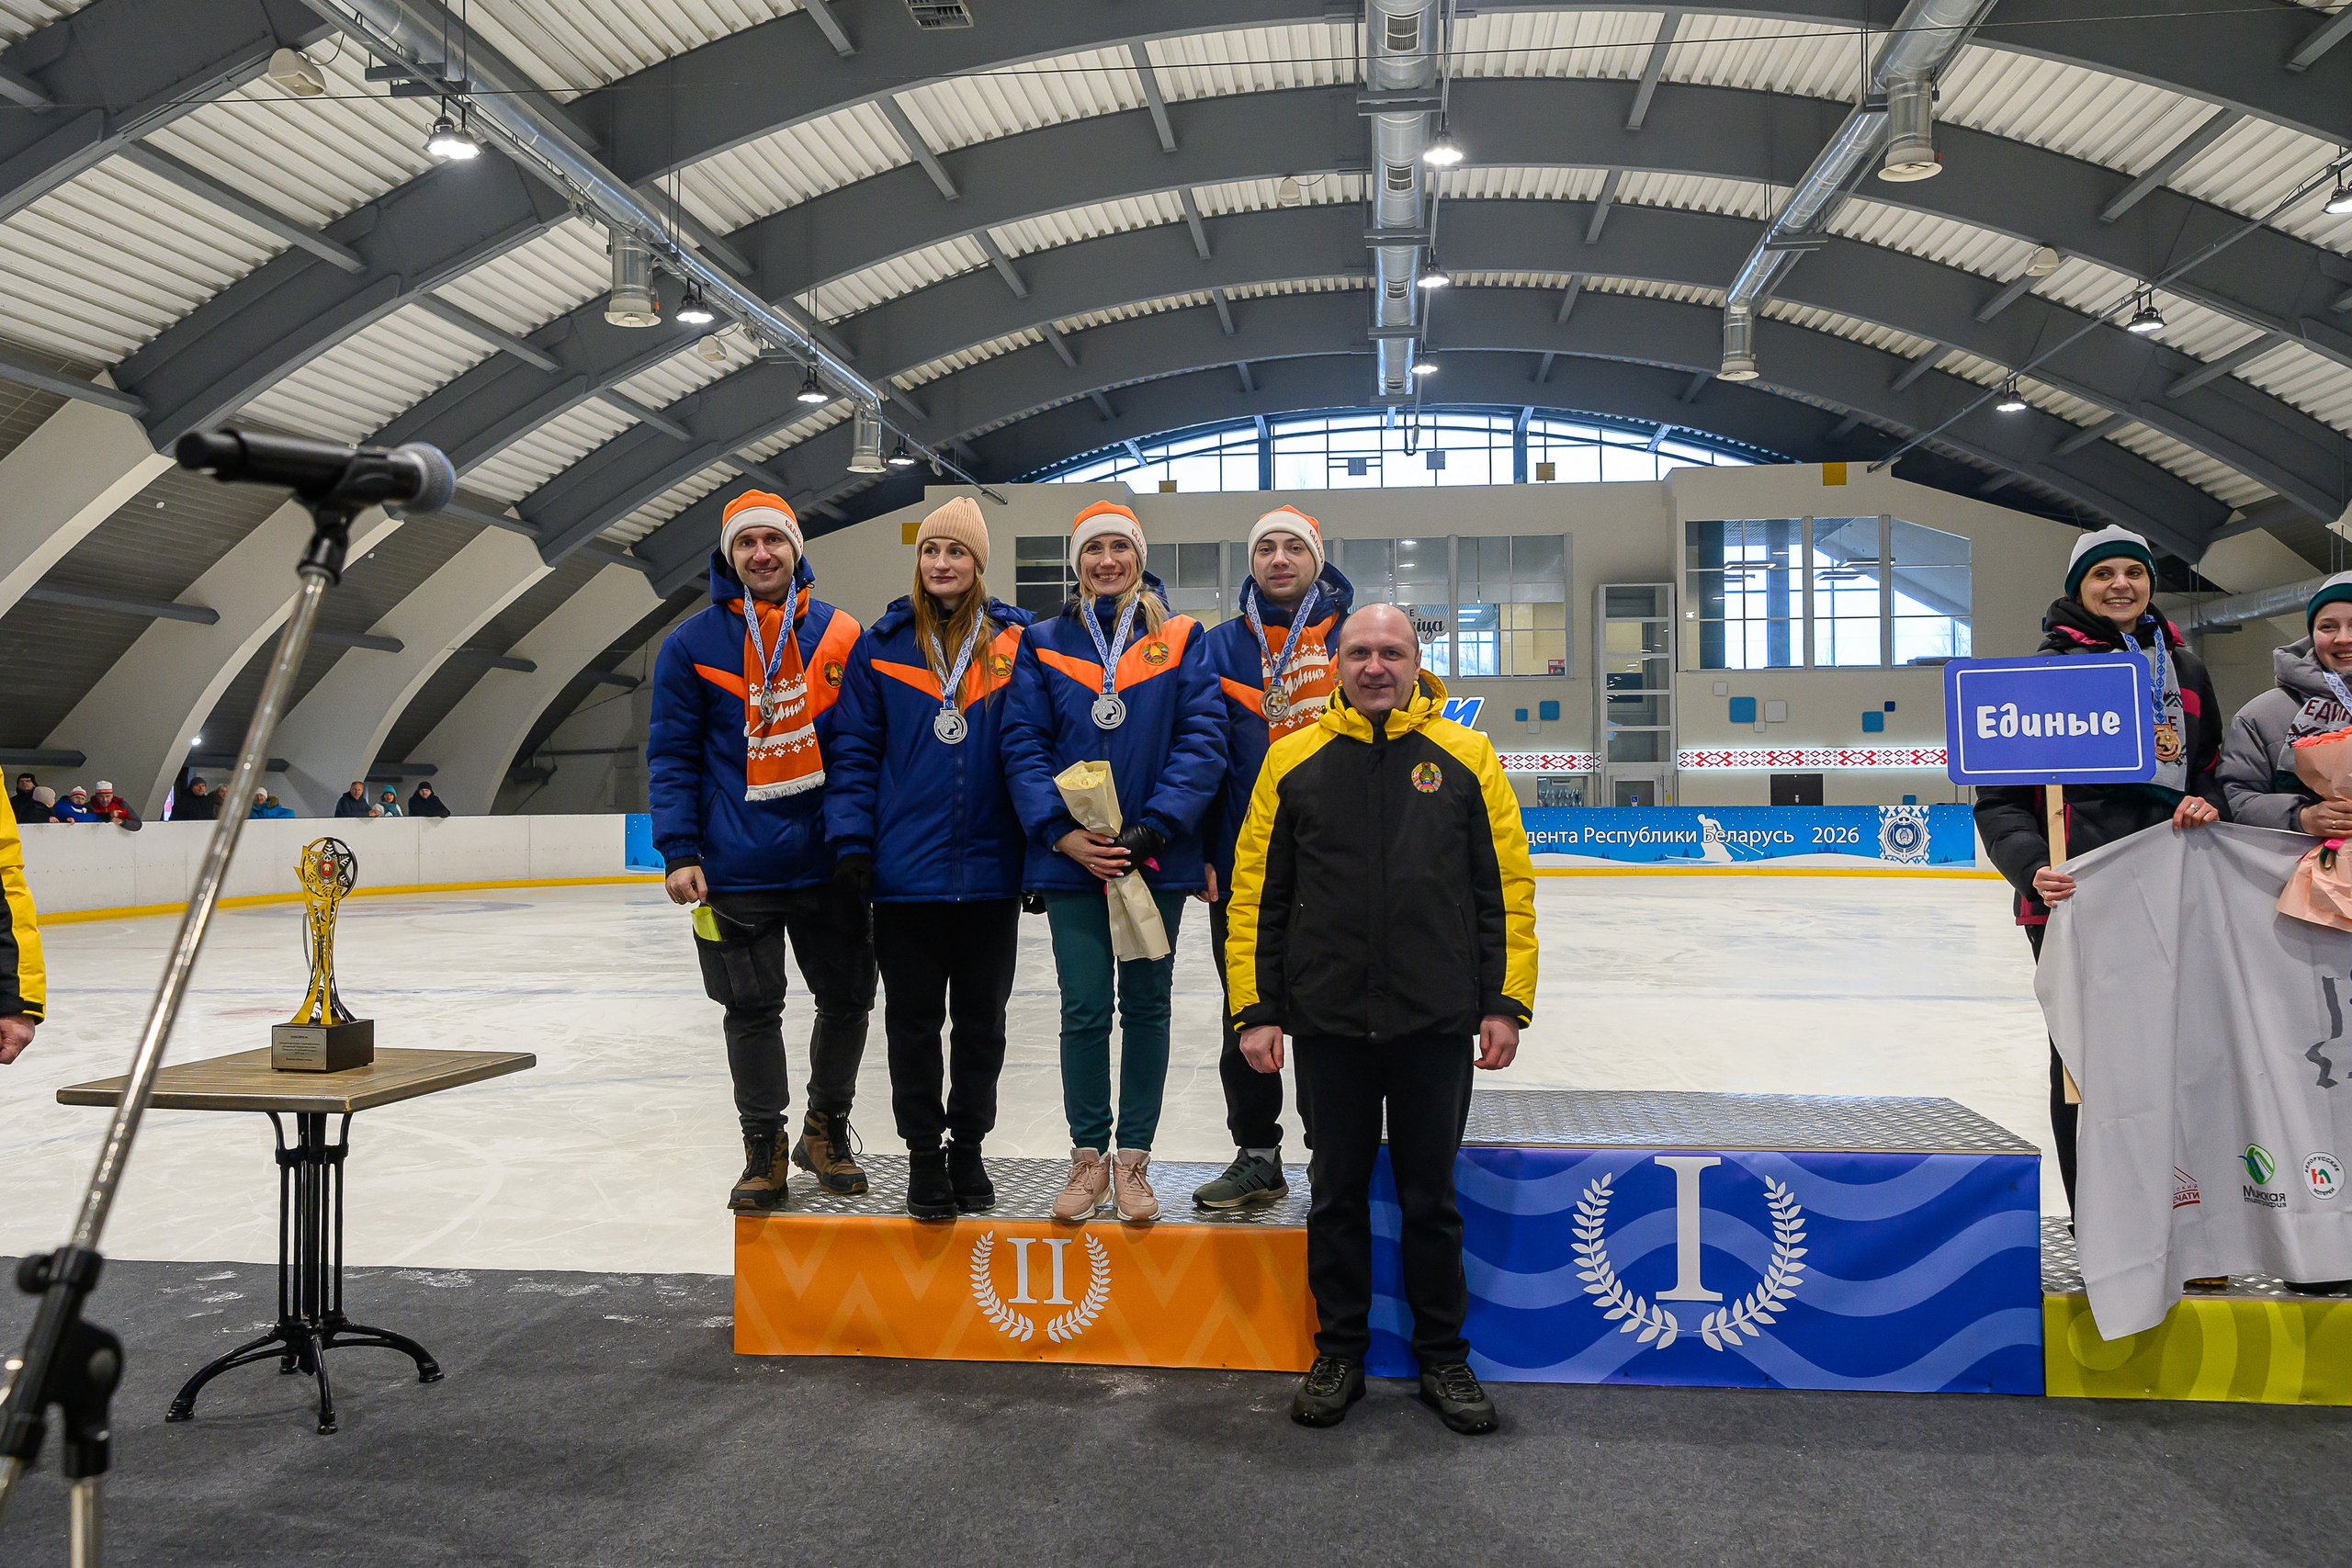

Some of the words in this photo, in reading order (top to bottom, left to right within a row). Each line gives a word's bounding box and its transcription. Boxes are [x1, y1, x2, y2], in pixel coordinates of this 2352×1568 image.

[1976, 702, 2120, 739] Единые
[1584, 826, 1697, 848] Республики
[1702, 826, 1795, 847] Беларусь
[1811, 827, 1860, 844] 2026
[1654, 1156, 1723, 1302] I
[1006, 1237, 1073, 1305] II
